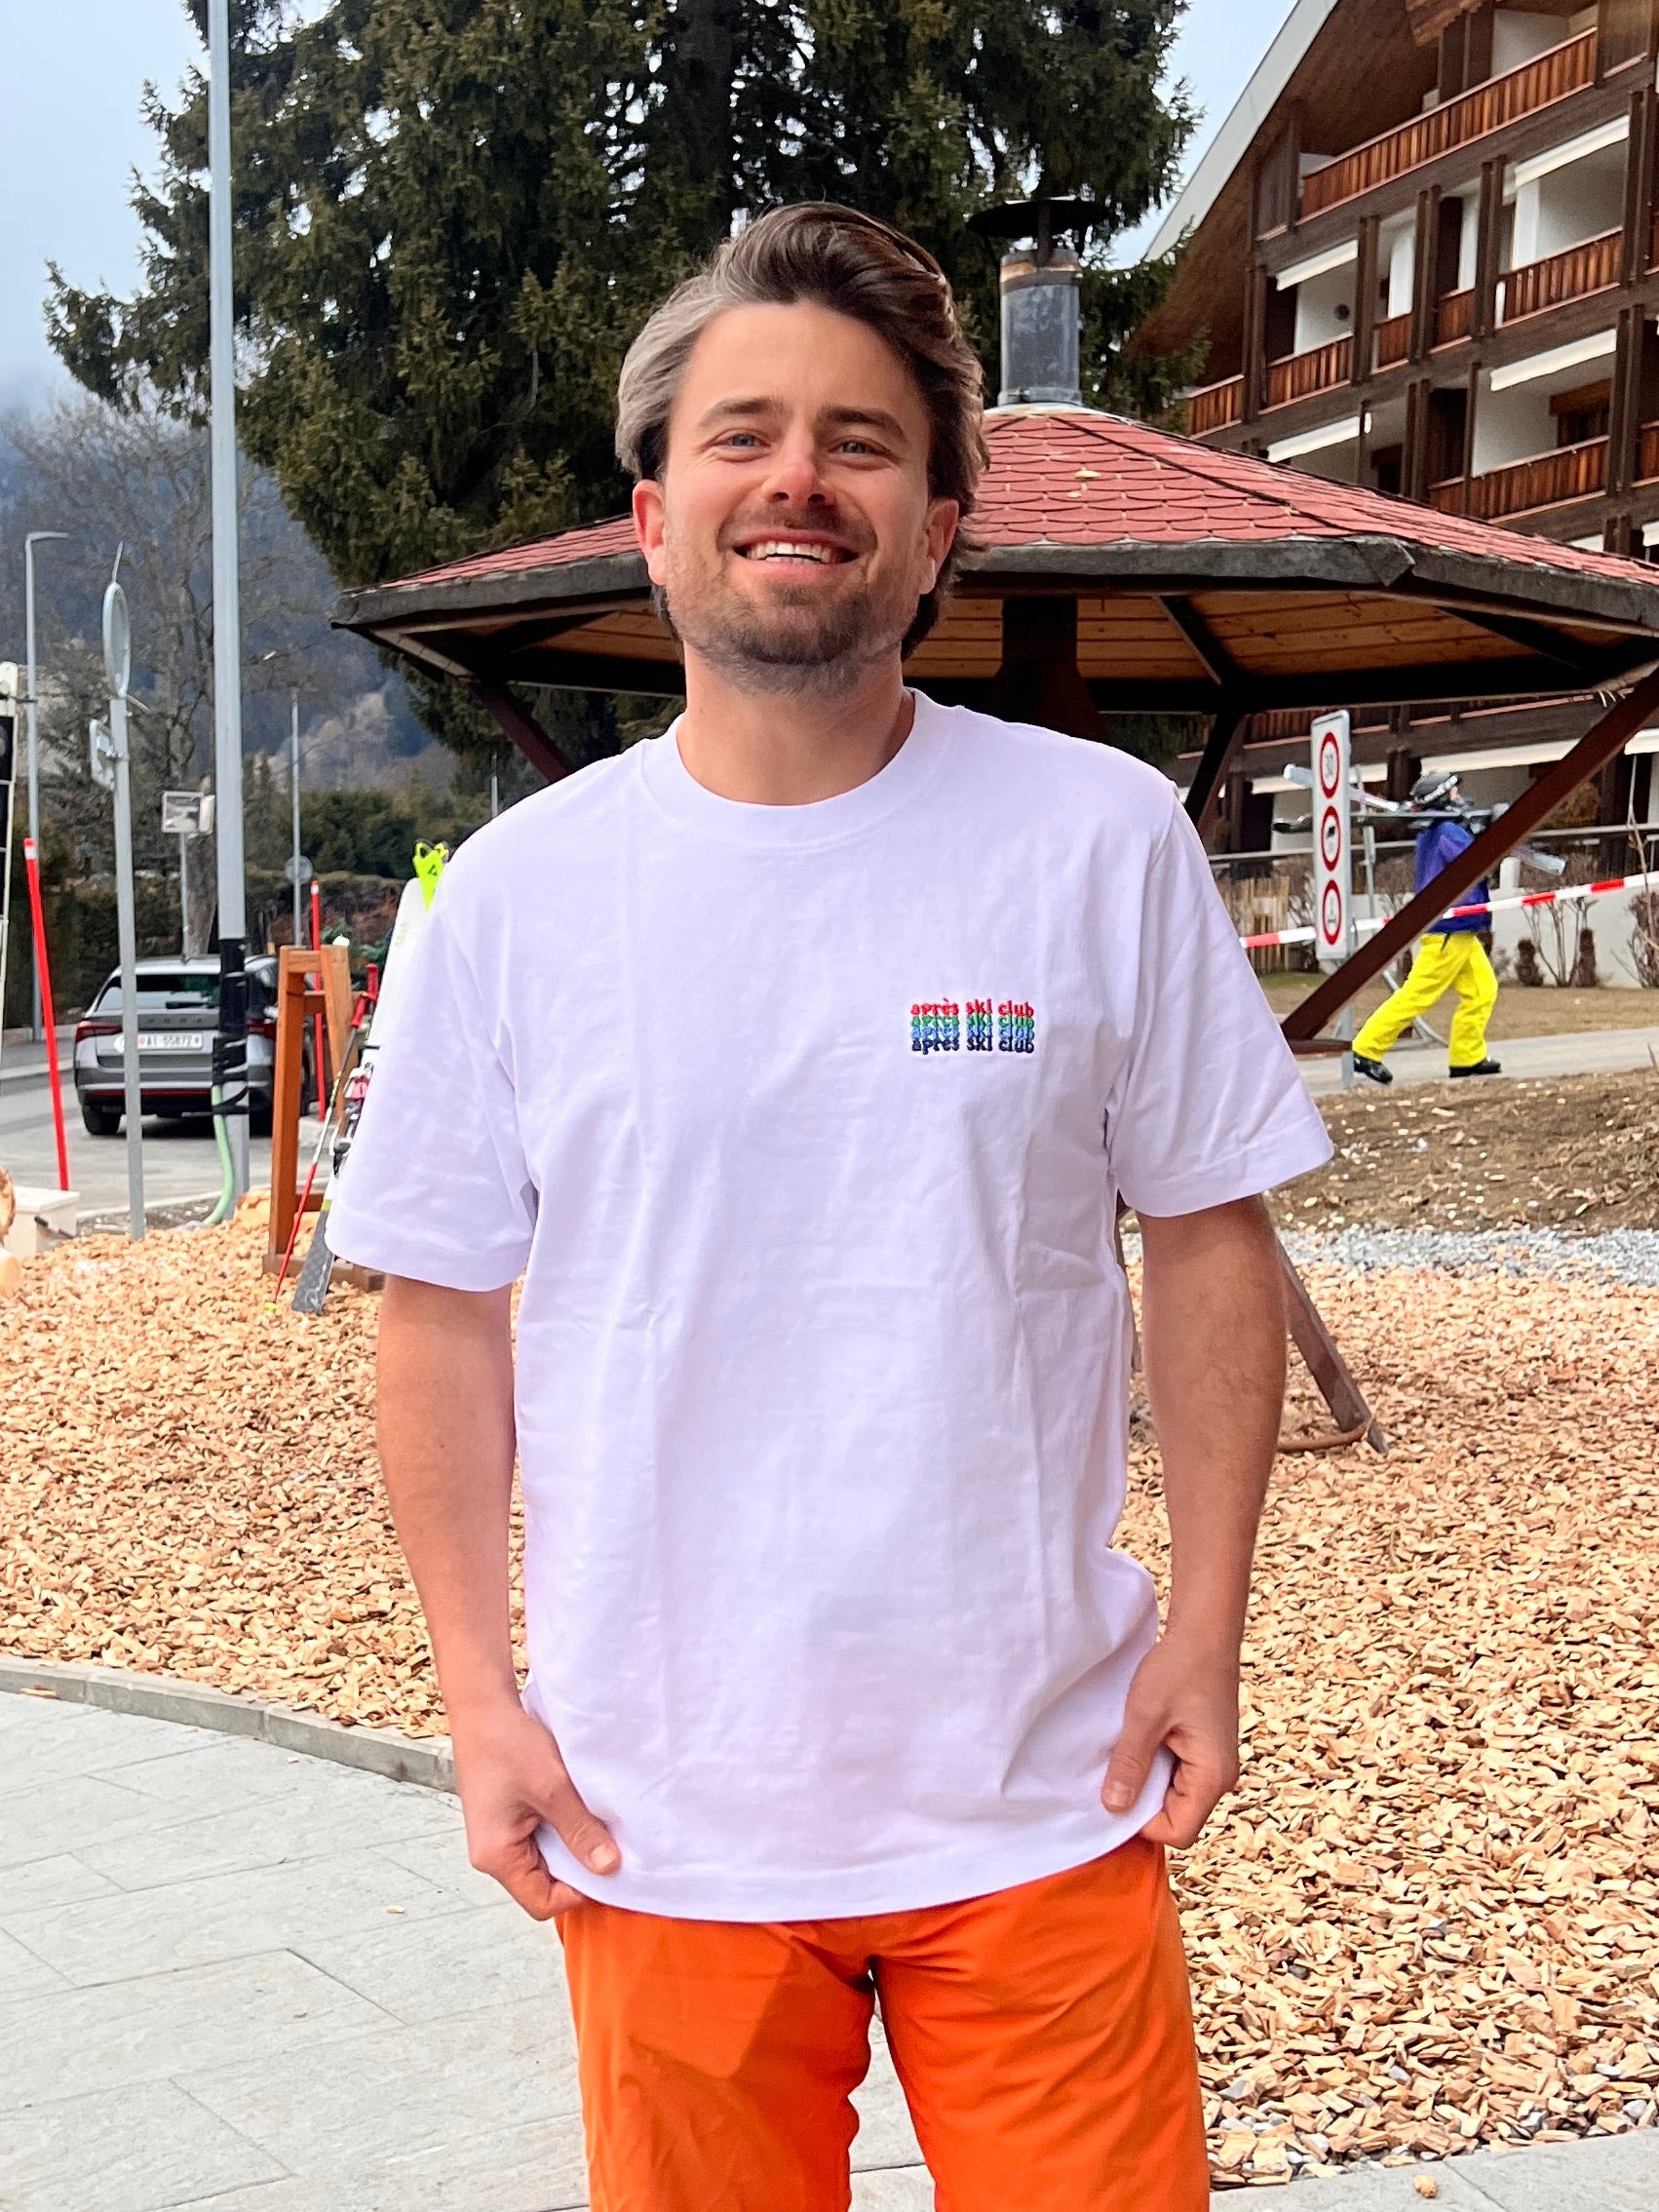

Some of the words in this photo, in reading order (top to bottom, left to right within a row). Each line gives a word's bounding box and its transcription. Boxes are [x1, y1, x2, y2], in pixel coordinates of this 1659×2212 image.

[910, 997, 959, 1016] après
[965, 998, 992, 1015] ski
[998, 999, 1034, 1018] club
[966, 1035, 992, 1052] ski
[998, 1035, 1034, 1053] club
